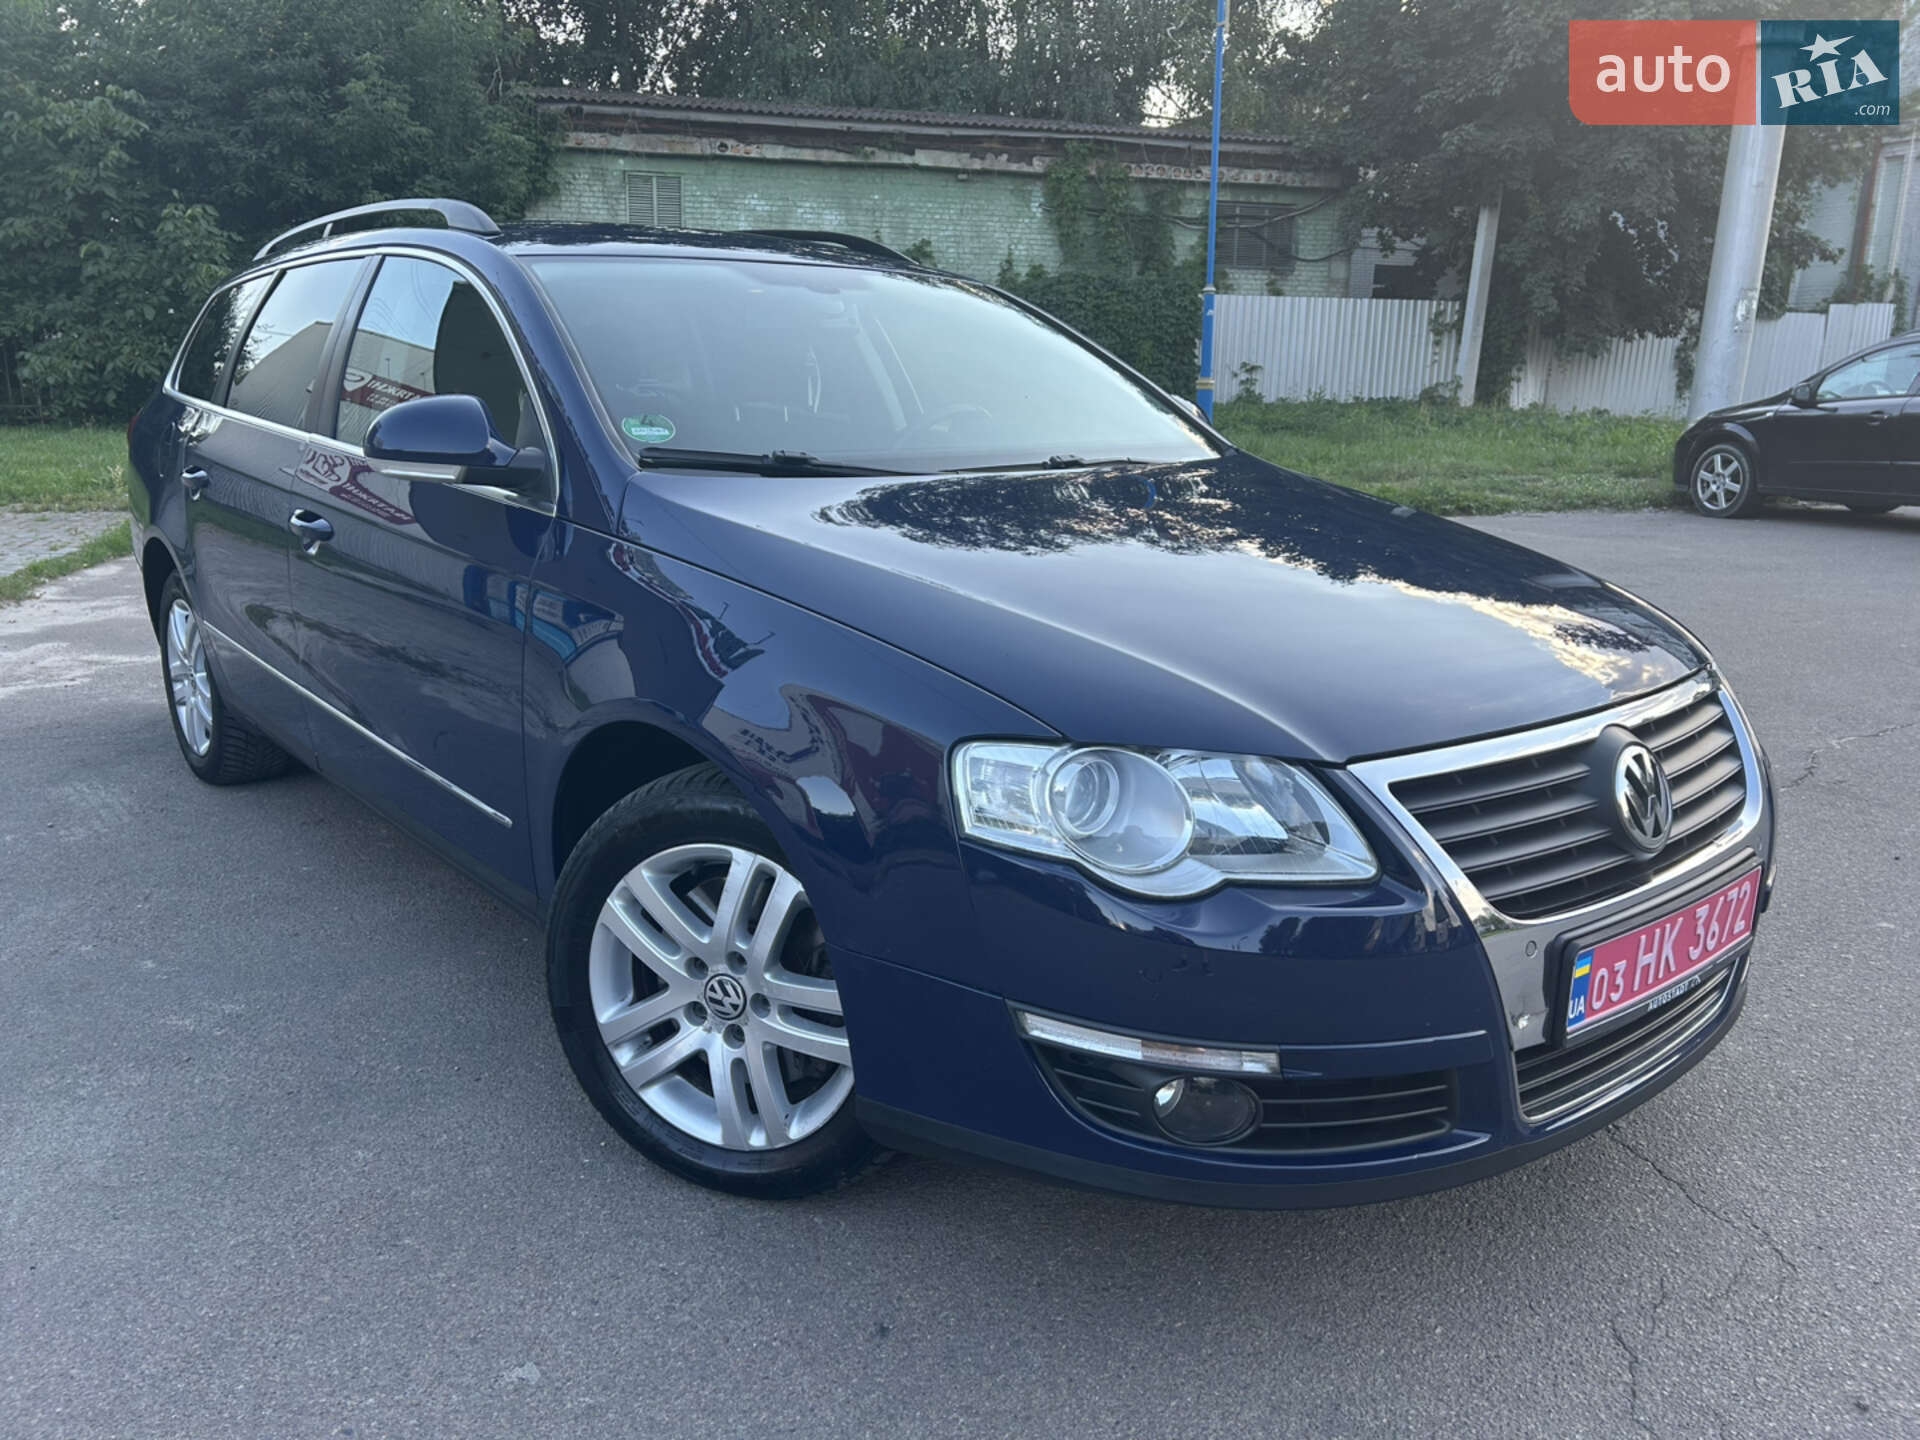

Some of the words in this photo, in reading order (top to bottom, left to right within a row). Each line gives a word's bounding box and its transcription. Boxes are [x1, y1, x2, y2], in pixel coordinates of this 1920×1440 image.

[1591, 959, 1627, 1010] 03
[1633, 917, 1683, 992] HK
[1689, 880, 1751, 960] 3672
[1568, 998, 1585, 1019] UA
